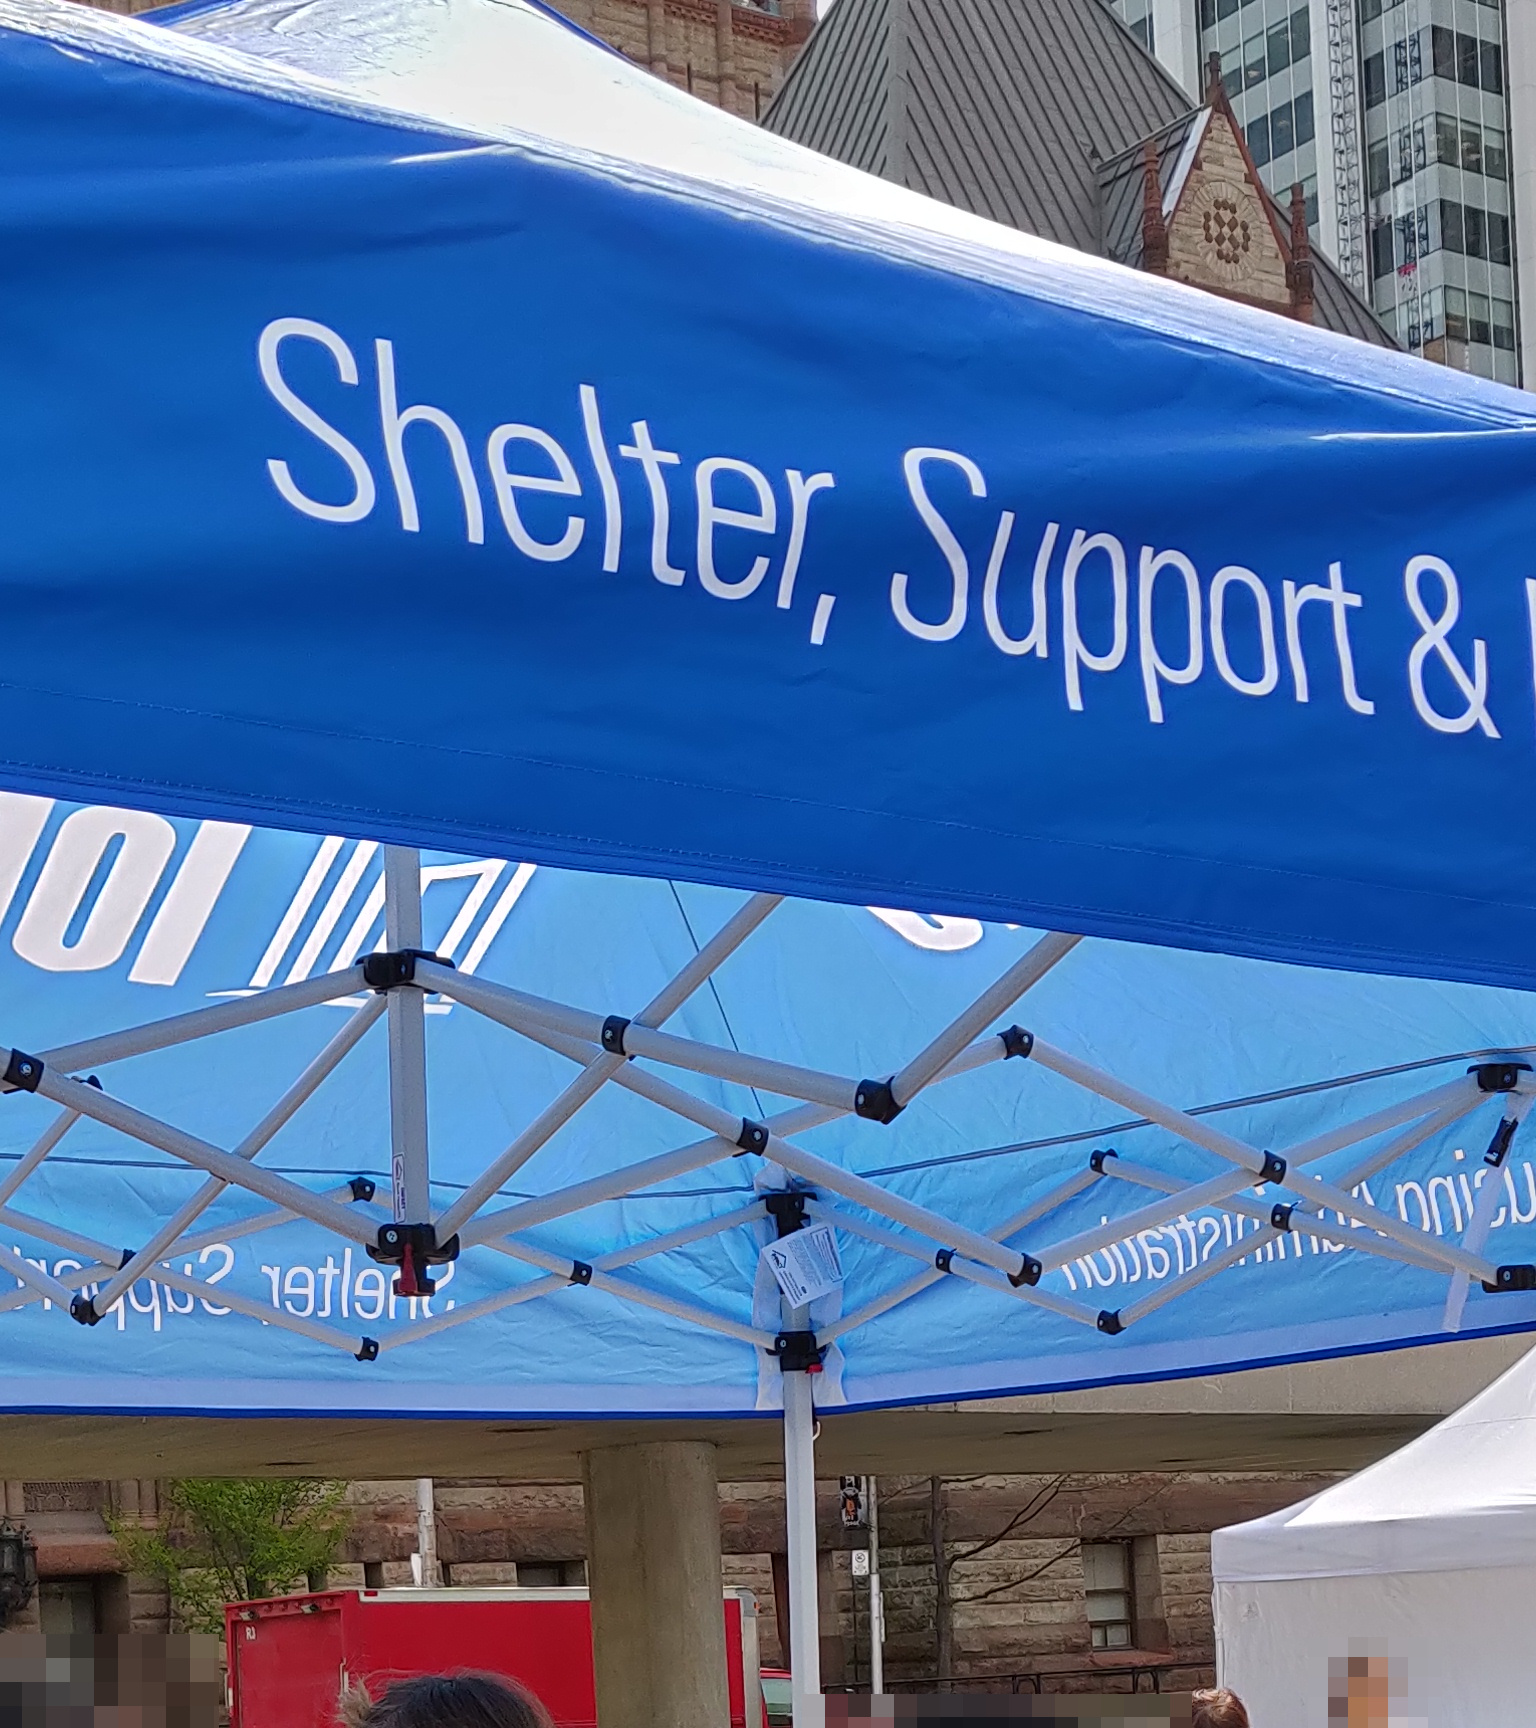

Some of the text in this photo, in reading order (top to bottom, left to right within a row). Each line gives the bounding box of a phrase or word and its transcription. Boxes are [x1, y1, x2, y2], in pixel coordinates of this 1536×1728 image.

[257, 316, 836, 645] Shelter,
[891, 446, 1375, 724] Support
[1405, 554, 1500, 739] &
